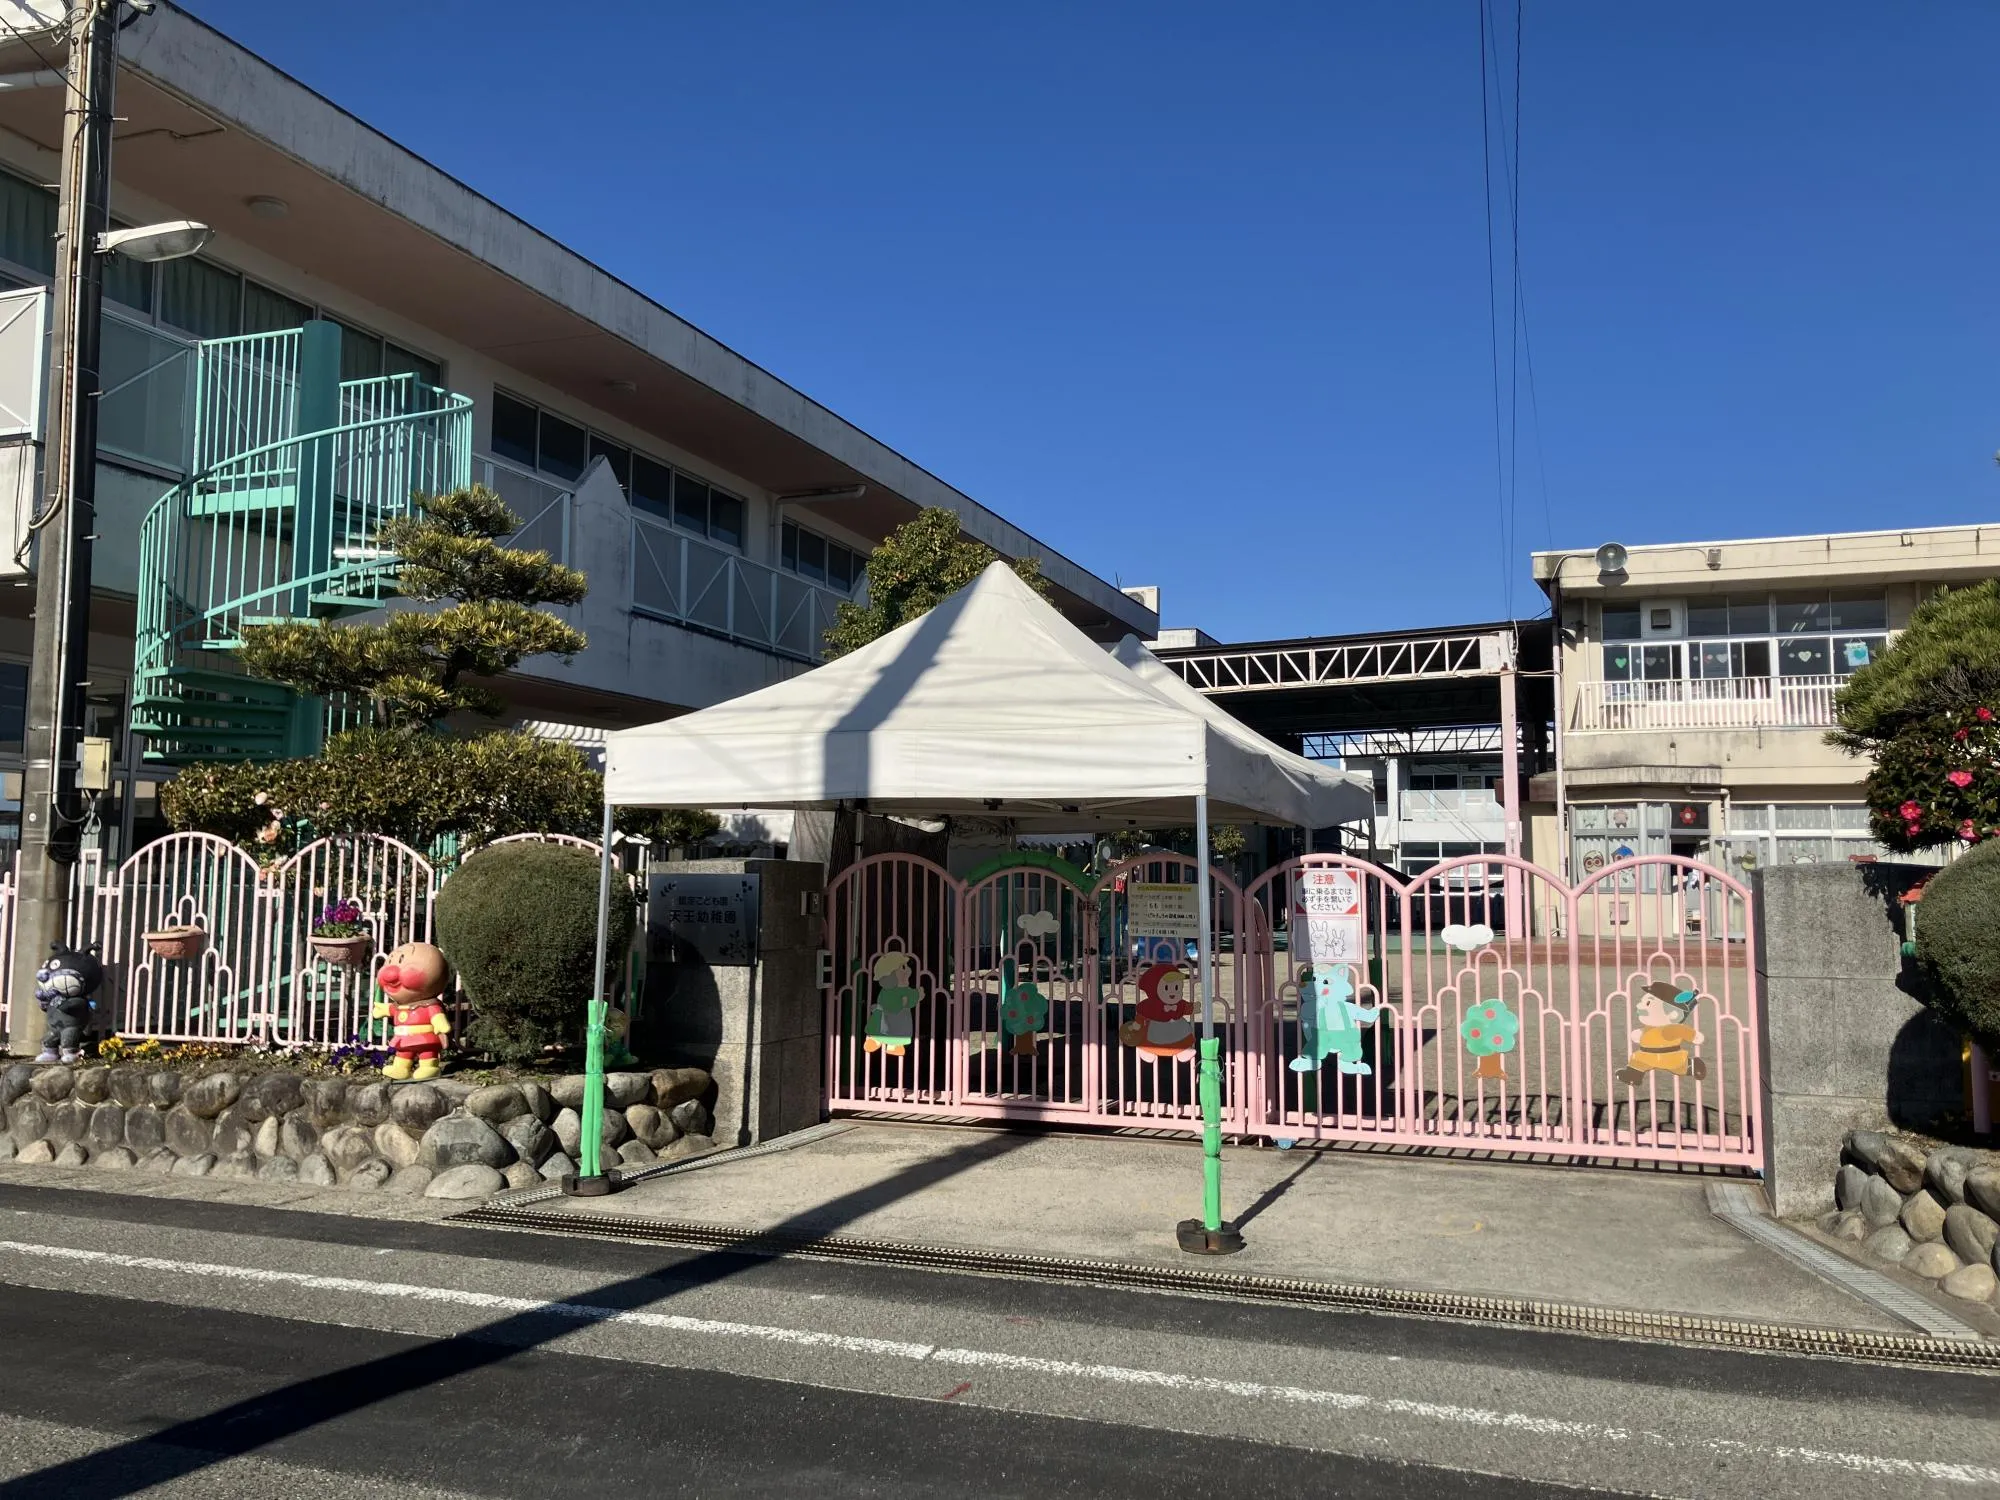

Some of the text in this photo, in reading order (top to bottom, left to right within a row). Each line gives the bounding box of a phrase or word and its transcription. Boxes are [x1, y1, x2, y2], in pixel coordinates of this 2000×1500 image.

[1312, 873, 1336, 885] 注意
[1311, 903, 1343, 912] ください。
[669, 909, 737, 925] 天王幼稚園
